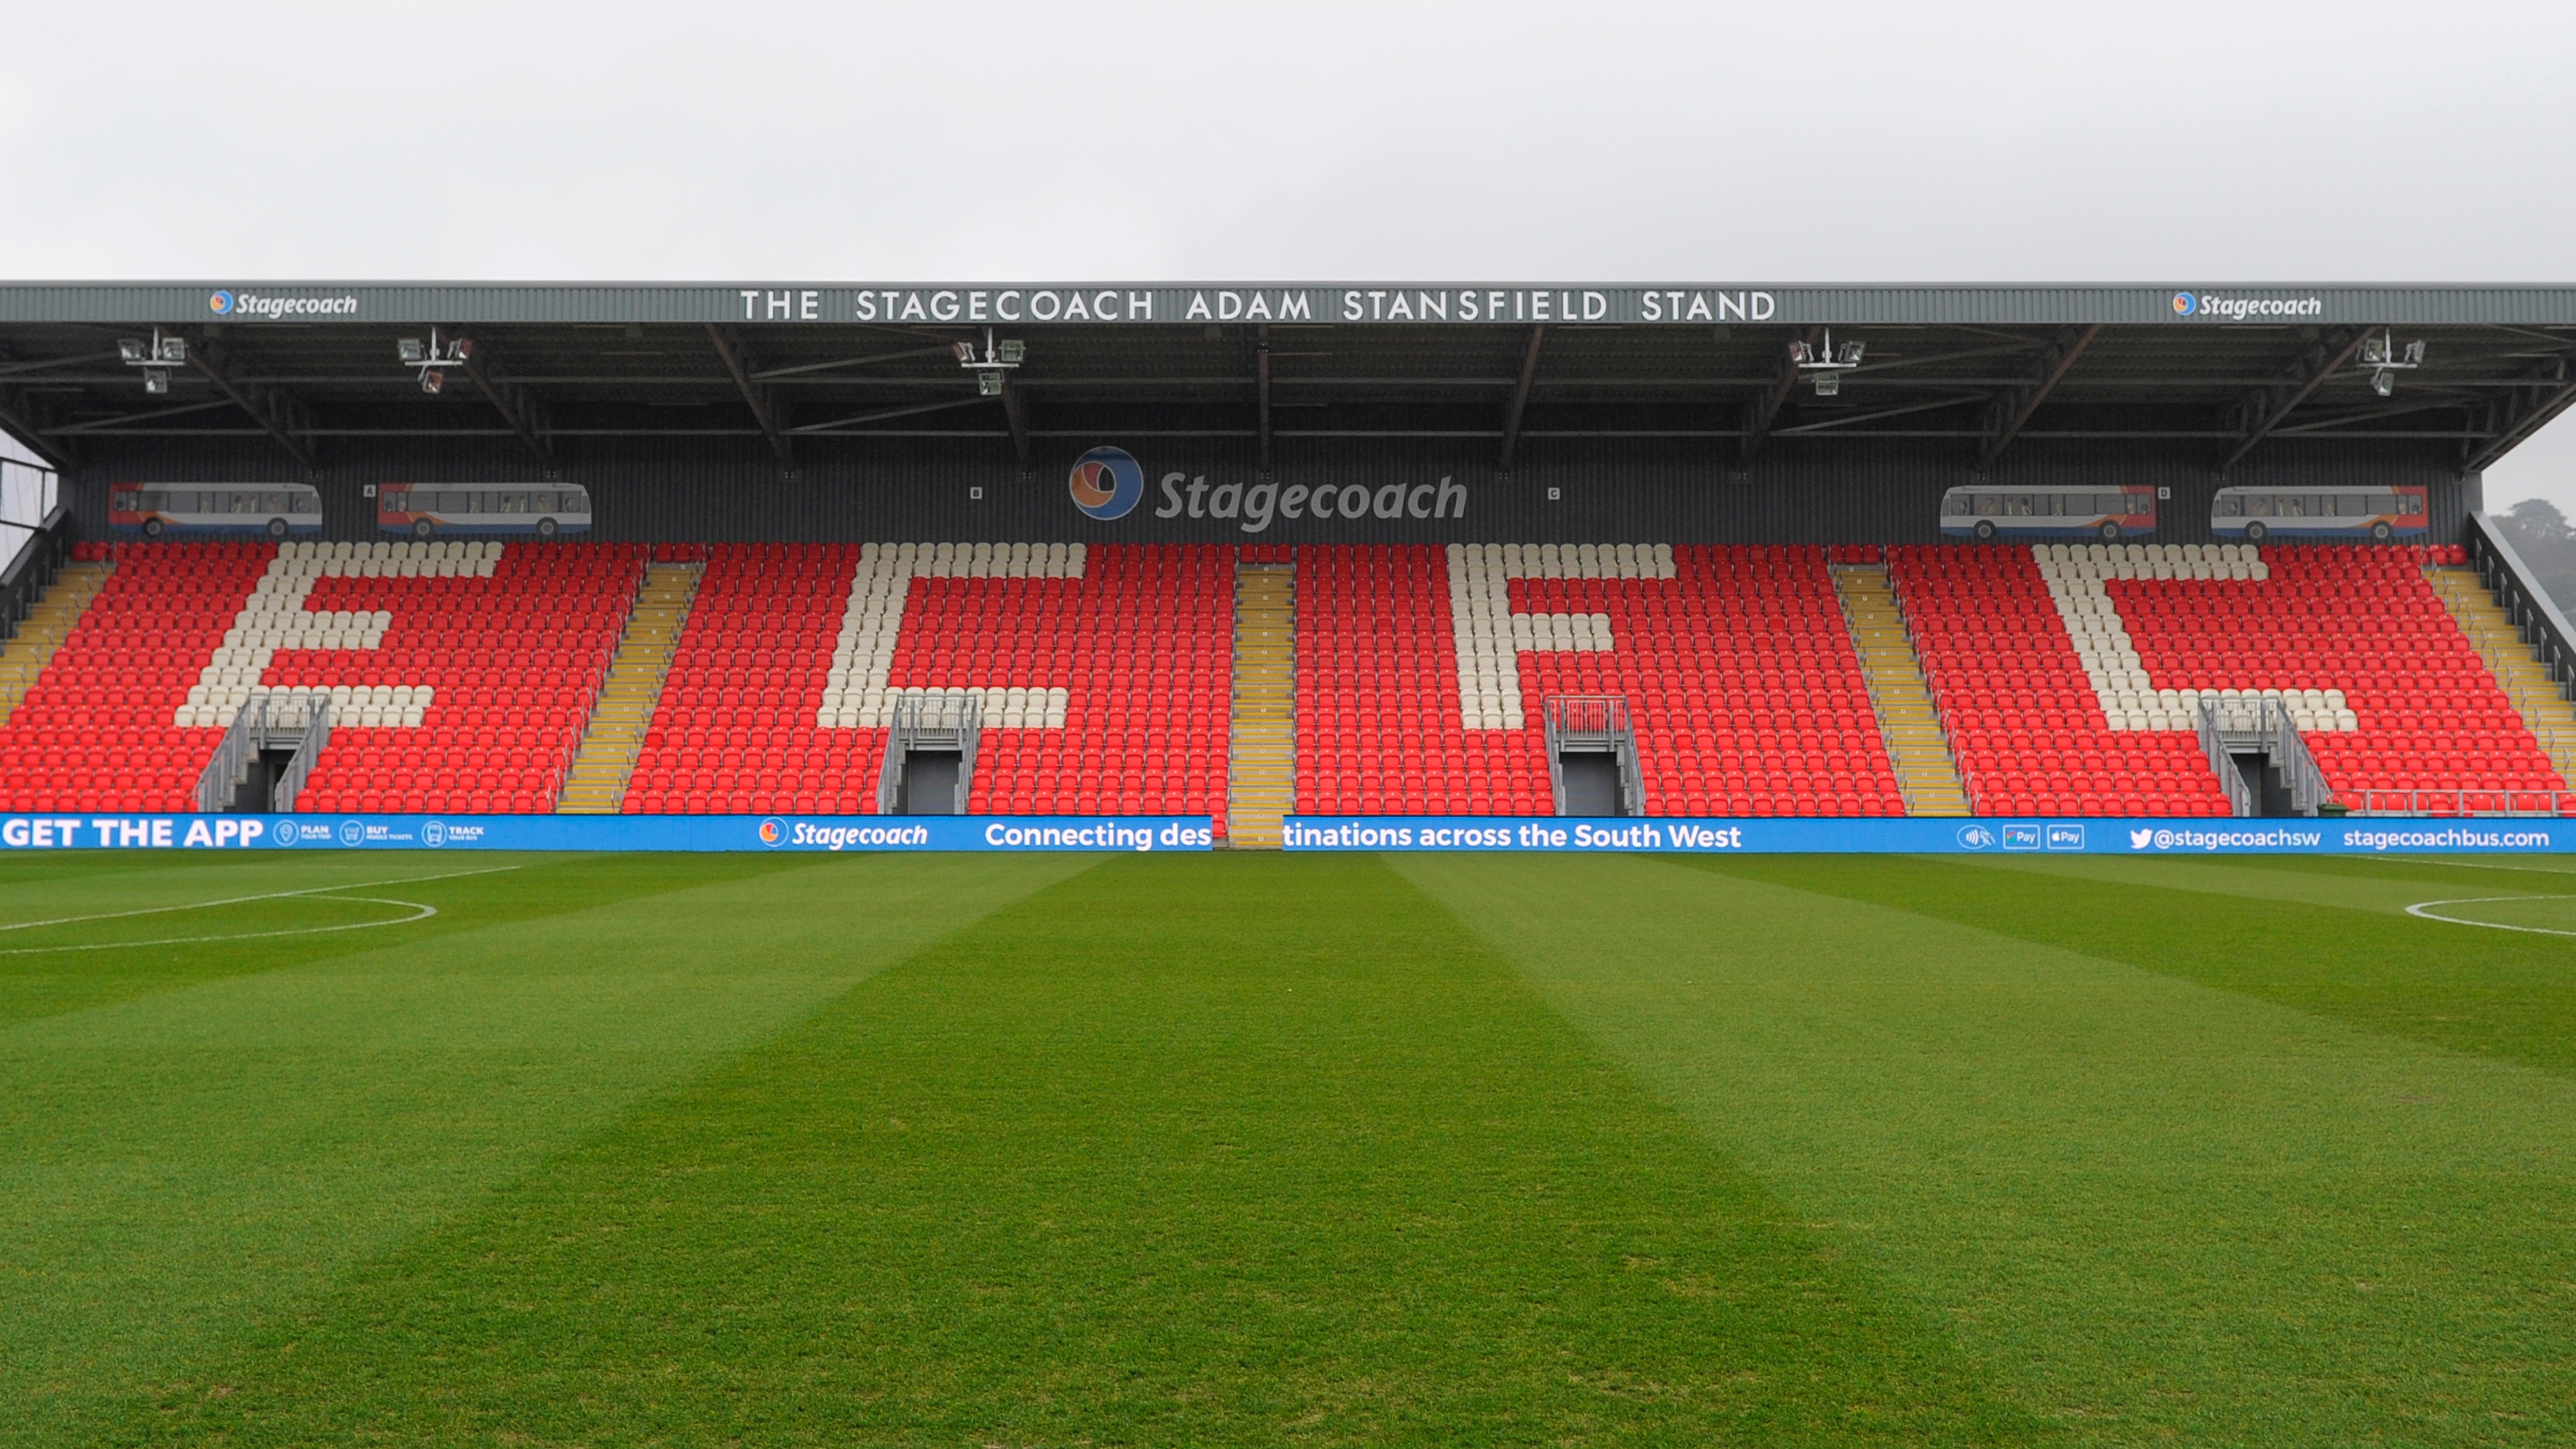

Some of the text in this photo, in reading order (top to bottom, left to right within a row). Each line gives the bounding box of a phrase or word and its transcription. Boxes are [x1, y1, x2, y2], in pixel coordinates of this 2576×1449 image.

[236, 293, 358, 318] Stagecoach
[741, 290, 1775, 322] THE STAGECOACH ADAM STANSFIELD STAND
[2198, 295, 2322, 321] Stagecoach
[1155, 472, 1468, 533] Stagecoach
[3, 820, 264, 847] GET THE APP
[301, 825, 329, 834] PLAN
[366, 825, 389, 834] BUY
[449, 826, 484, 835] TRACK
[792, 823, 928, 850] Stagecoach
[985, 822, 1212, 851] Connecting des
[1283, 822, 1742, 848] tinations across the South West
[2061, 832, 2080, 844] Pay
[2153, 829, 2322, 850] @stagecoachsw
[2343, 829, 2550, 850] stagecoachbus.com
